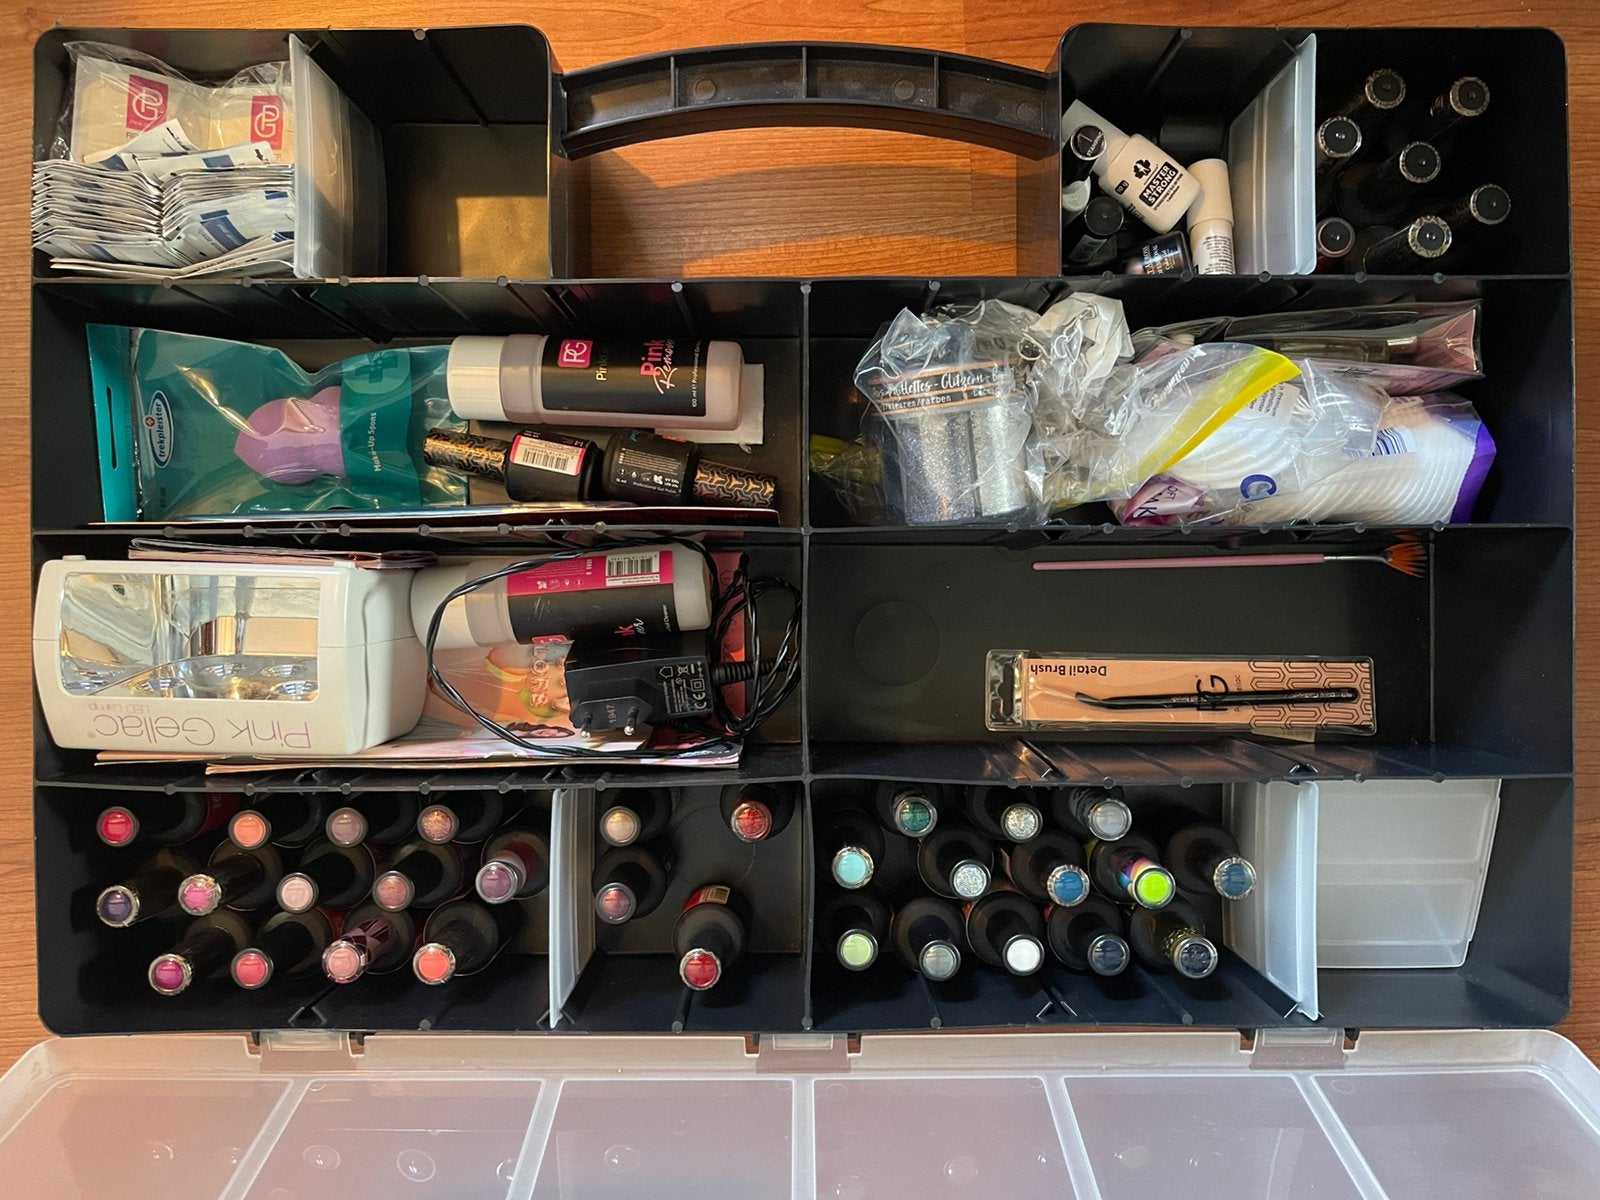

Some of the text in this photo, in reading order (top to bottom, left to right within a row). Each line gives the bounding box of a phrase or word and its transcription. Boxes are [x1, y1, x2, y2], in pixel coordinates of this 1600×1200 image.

[1142, 165, 1171, 199] MASTER
[1148, 171, 1177, 204] STRONG
[640, 339, 666, 377] Pink
[941, 371, 984, 391] Glitzern
[157, 403, 168, 458] trekpleister
[368, 411, 382, 472] Make-Up Spons
[1030, 663, 1107, 677] Detail Brush
[88, 702, 150, 715] LED Lamp
[607, 704, 617, 724] 1947
[94, 713, 312, 750] Pink Gellac
